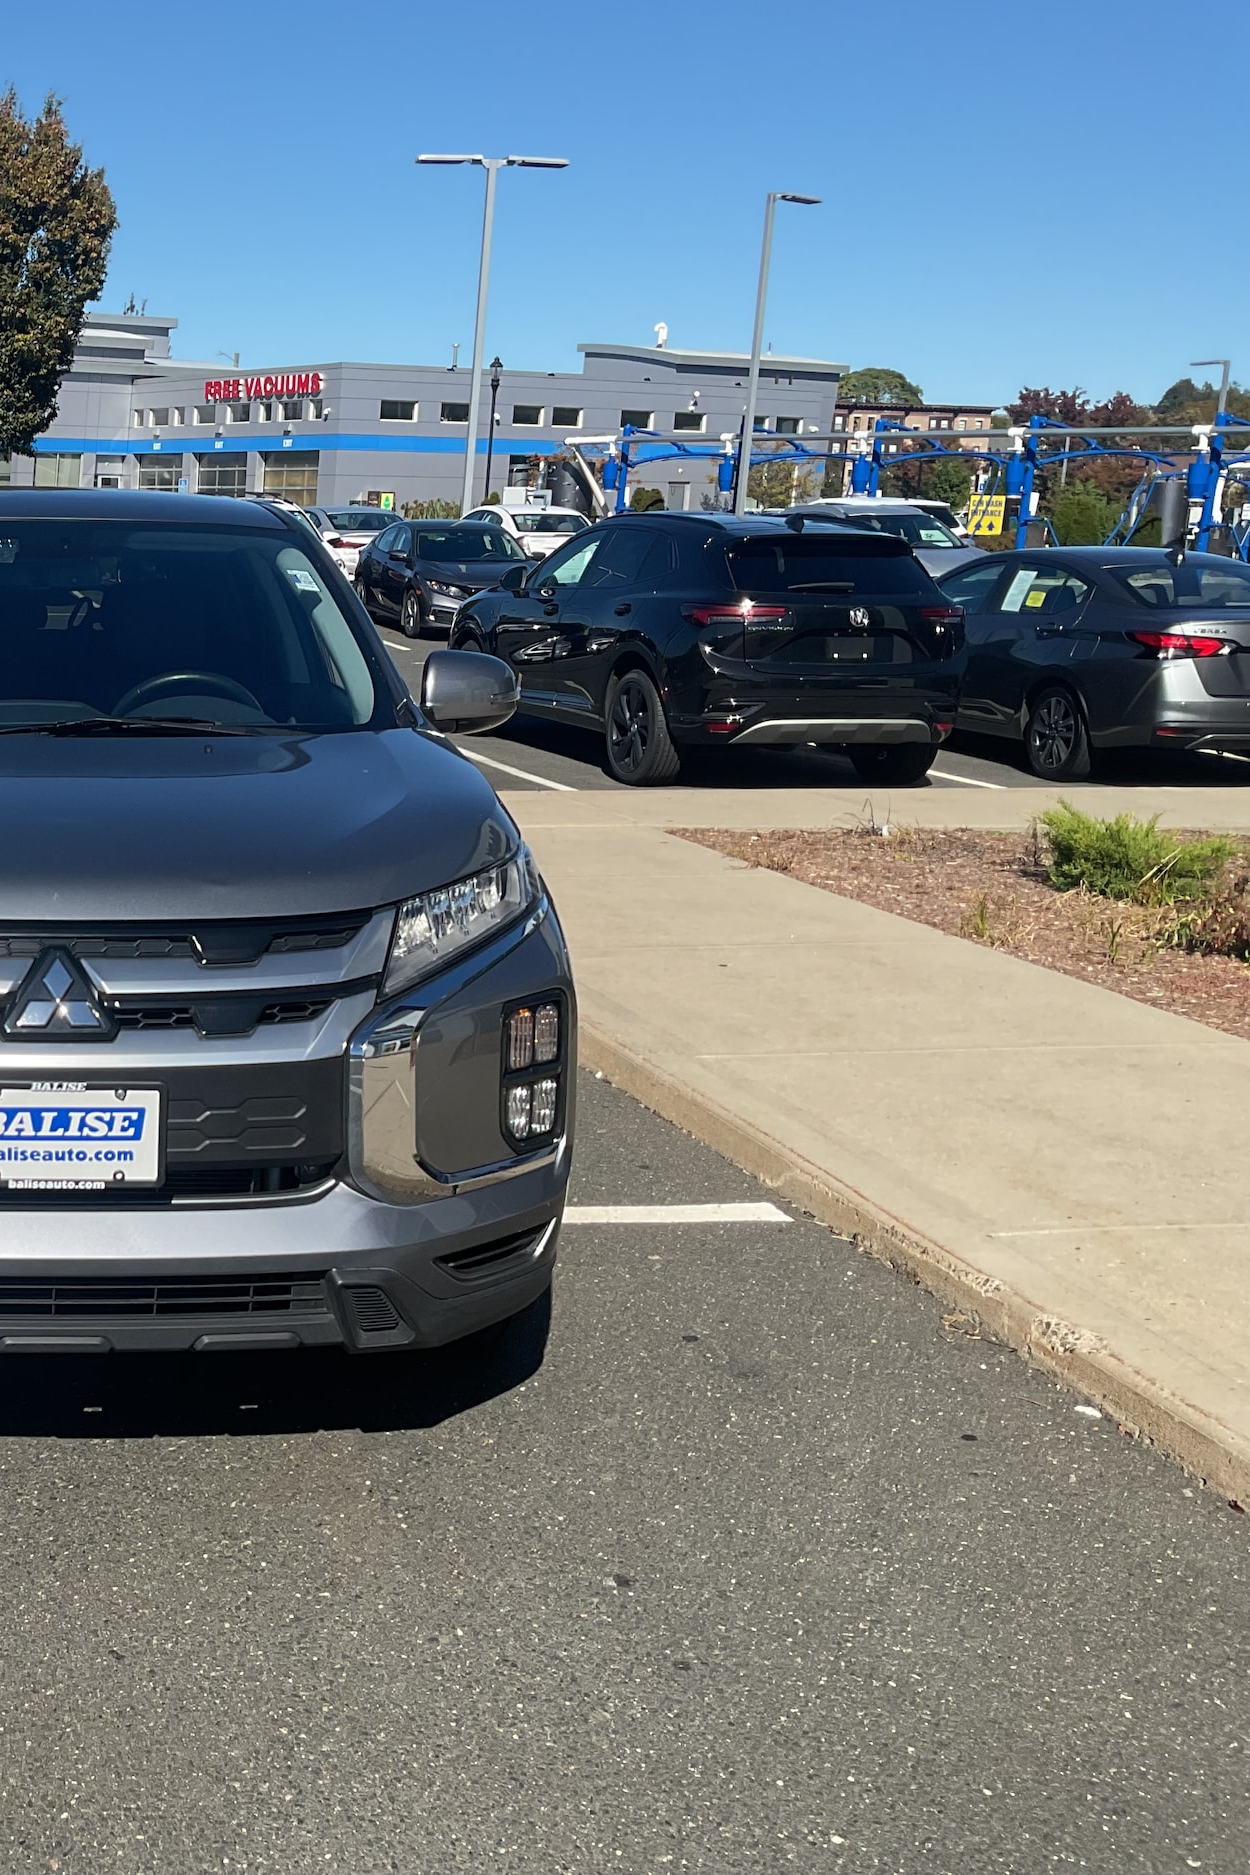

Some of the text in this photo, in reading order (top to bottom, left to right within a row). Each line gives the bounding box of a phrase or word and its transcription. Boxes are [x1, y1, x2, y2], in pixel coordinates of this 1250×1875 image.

[205, 372, 323, 400] FREE VACUUMS
[30, 1082, 88, 1092] BALISE
[7, 1179, 106, 1190] baliseauto.com
